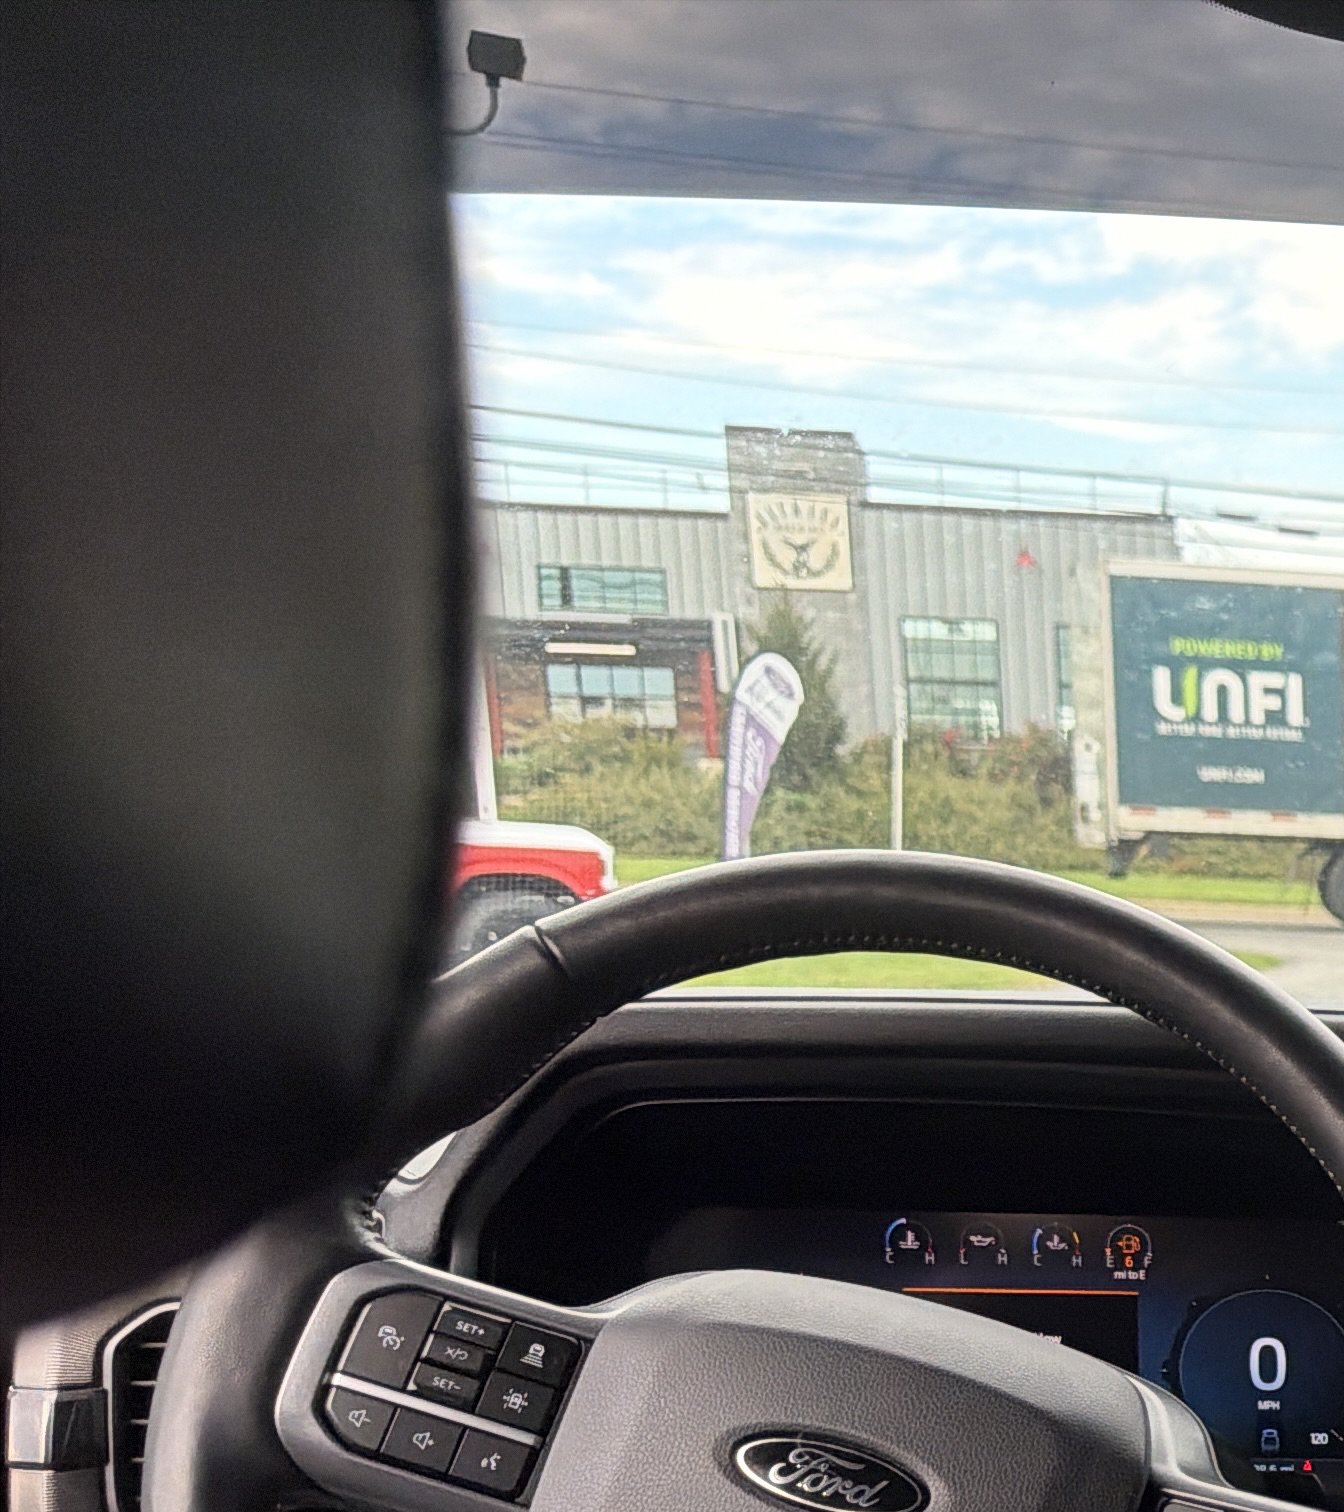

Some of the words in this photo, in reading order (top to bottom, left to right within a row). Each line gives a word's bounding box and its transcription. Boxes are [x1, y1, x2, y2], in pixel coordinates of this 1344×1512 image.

[925, 1253, 935, 1264] H
[998, 1254, 1008, 1265] H
[1072, 1255, 1082, 1266] H
[1106, 1256, 1114, 1268] E
[1125, 1256, 1133, 1268] 6
[456, 1321, 486, 1336] SET+
[1249, 1337, 1287, 1391] 0
[1257, 1400, 1280, 1410] MPH
[1310, 1432, 1329, 1444] 120
[768, 1447, 890, 1511] Ford
